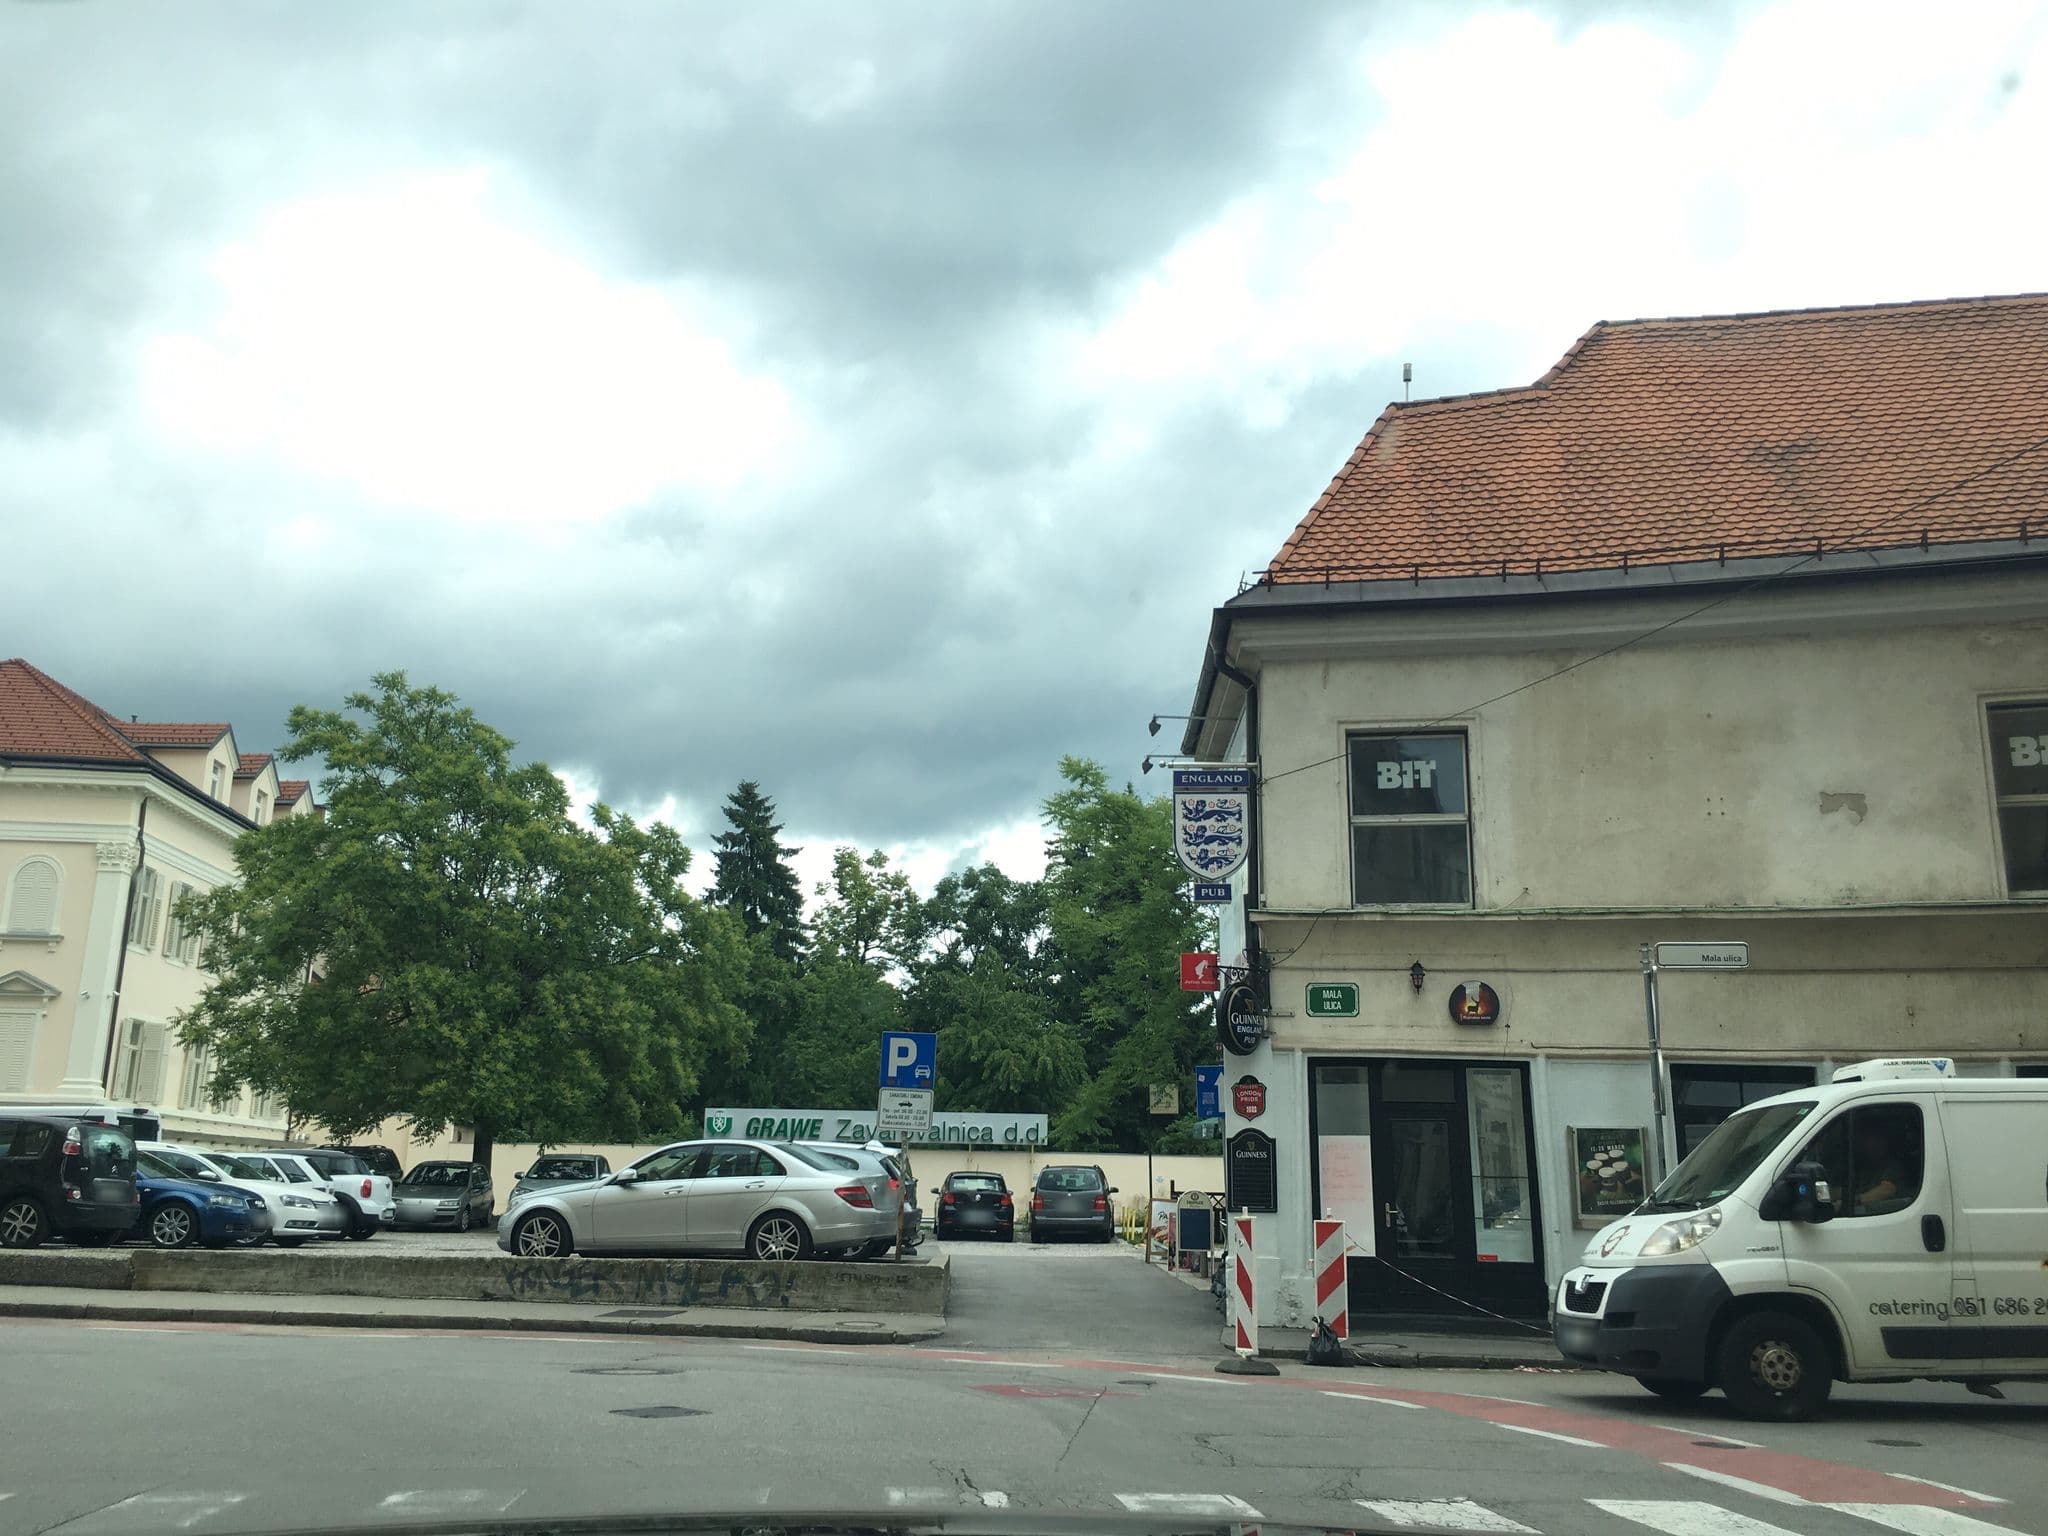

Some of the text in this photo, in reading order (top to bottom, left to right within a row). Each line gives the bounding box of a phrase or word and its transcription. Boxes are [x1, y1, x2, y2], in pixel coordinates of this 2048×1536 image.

[1181, 774, 1243, 783] ENGLAND
[1201, 888, 1225, 896] PUB
[1701, 954, 1742, 962] Mala ulica
[1322, 990, 1342, 999] MALA
[1323, 1001, 1341, 1010] ULICA
[887, 1037, 917, 1078] P
[745, 1117, 823, 1138] GRAWE
[1004, 1122, 1047, 1142] d.d.
[1869, 1297, 2048, 1321] catering 051 686 2
